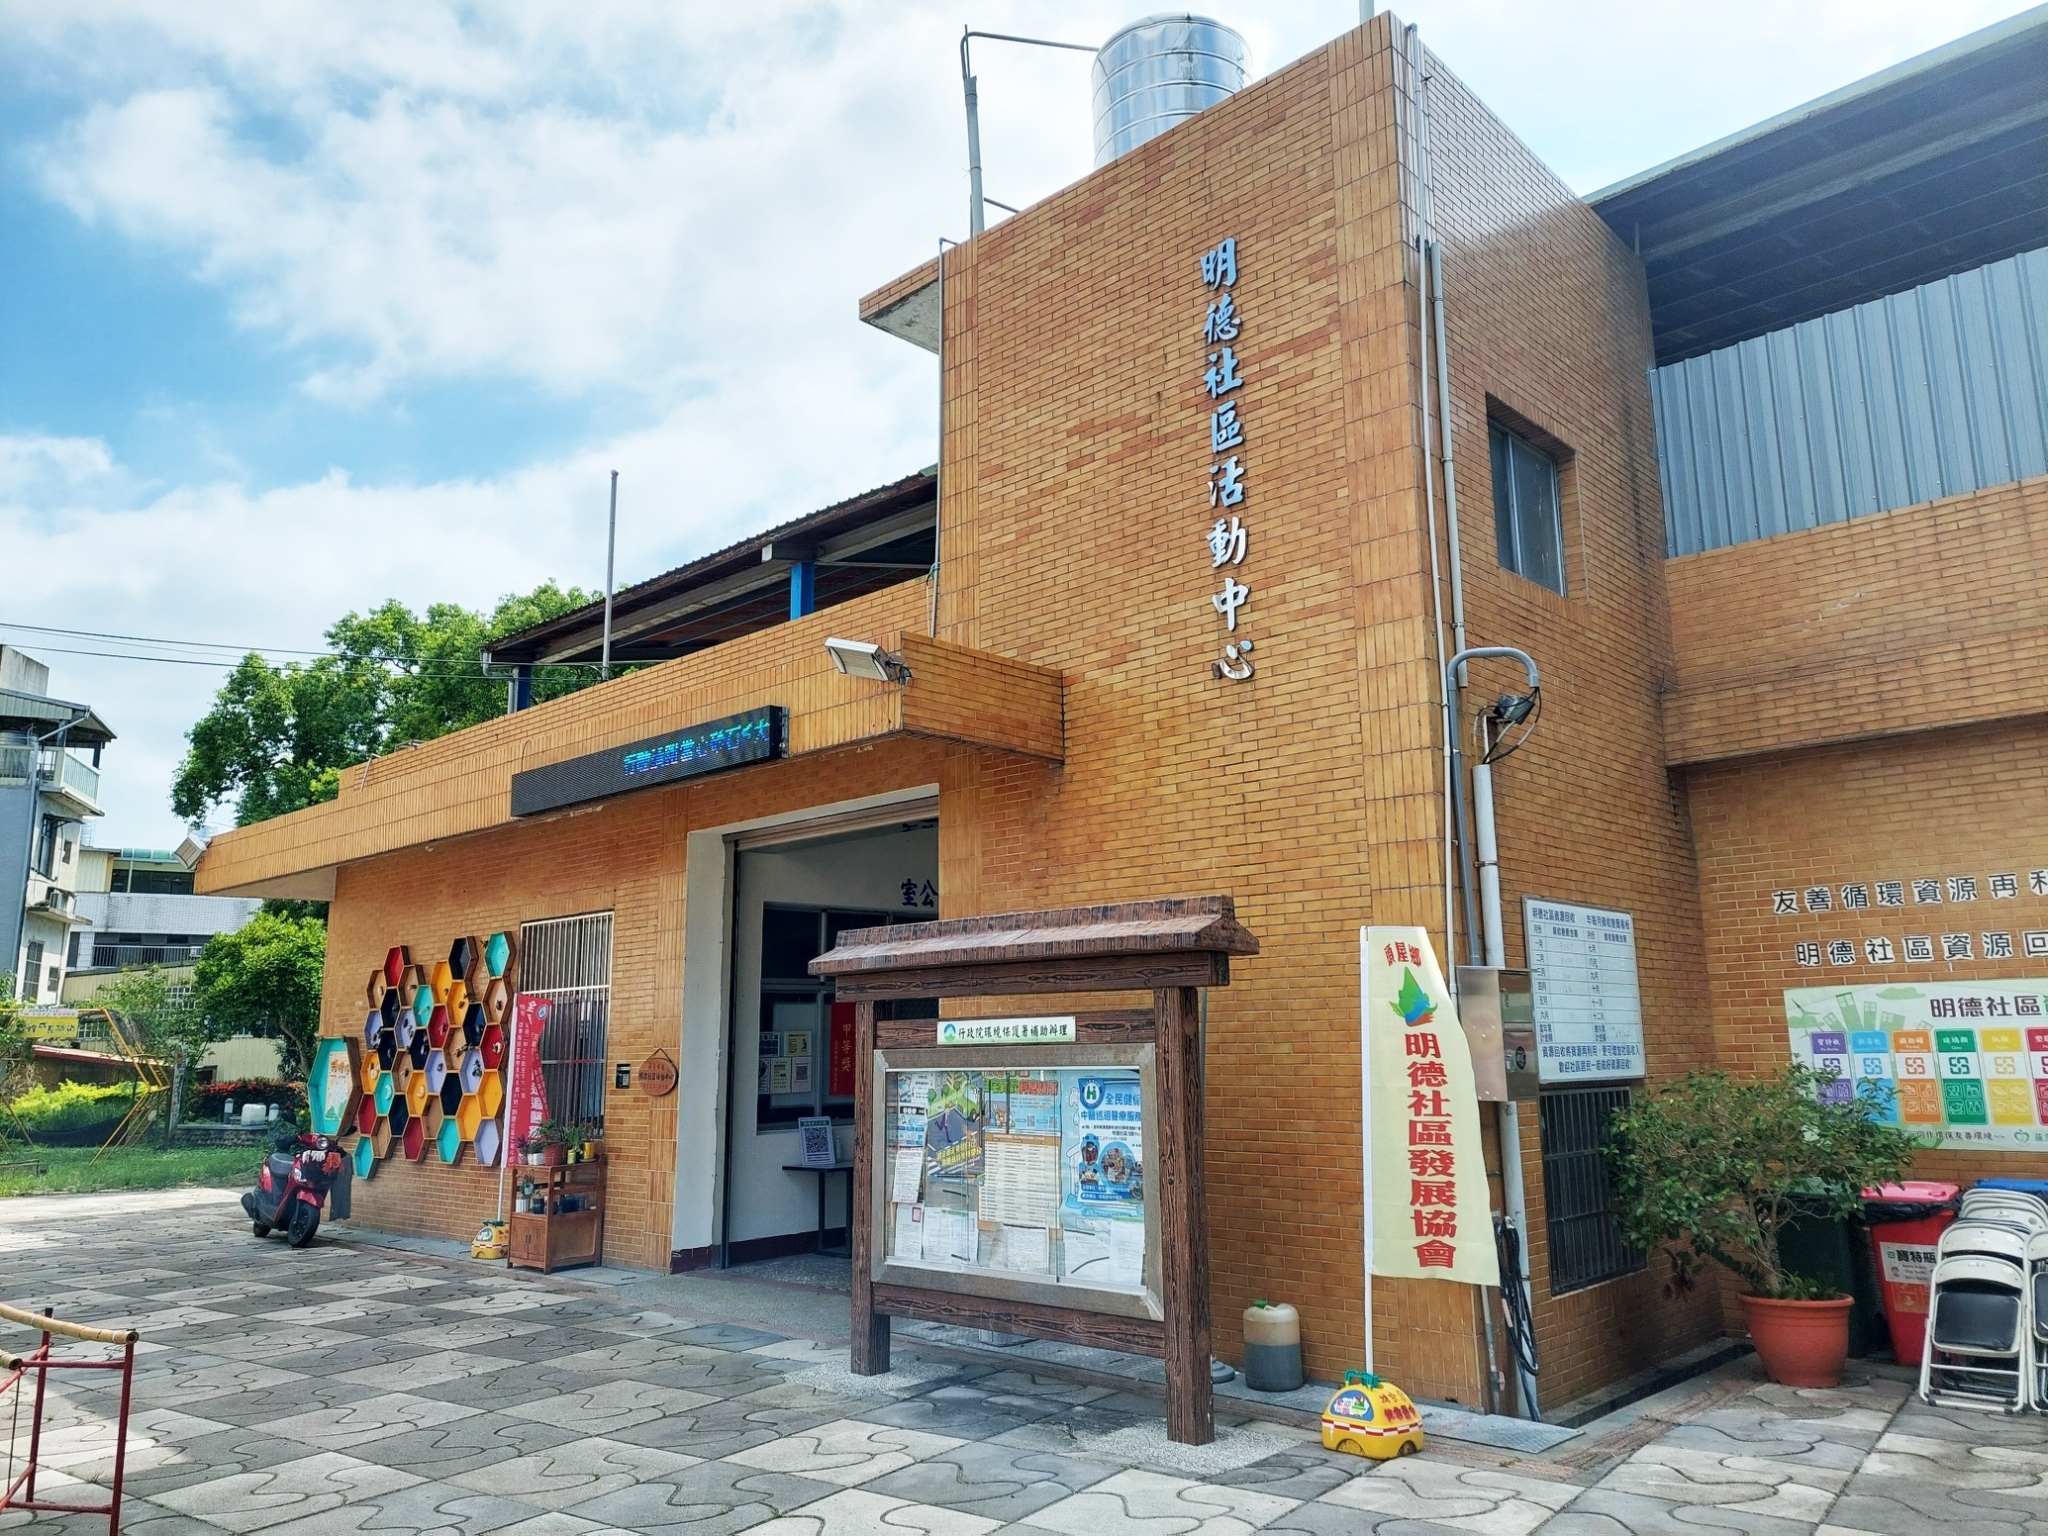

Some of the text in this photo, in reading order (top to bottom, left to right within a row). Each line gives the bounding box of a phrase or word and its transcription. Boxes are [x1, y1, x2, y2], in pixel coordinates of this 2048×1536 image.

[1200, 237, 1255, 681] 明德社區活動中心
[1588, 944, 1597, 953] 七月
[1796, 931, 2048, 966] 明德社區資源回
[1538, 981, 1547, 991] 四月
[1540, 995, 1548, 1006] 五月
[1930, 995, 2048, 1018] 明德社區
[958, 1023, 1068, 1039] 行政院環境保護署補助辦理
[1404, 1032, 1458, 1269] 明德社區發展協會
[1896, 1250, 1936, 1264] 寶特瓶
